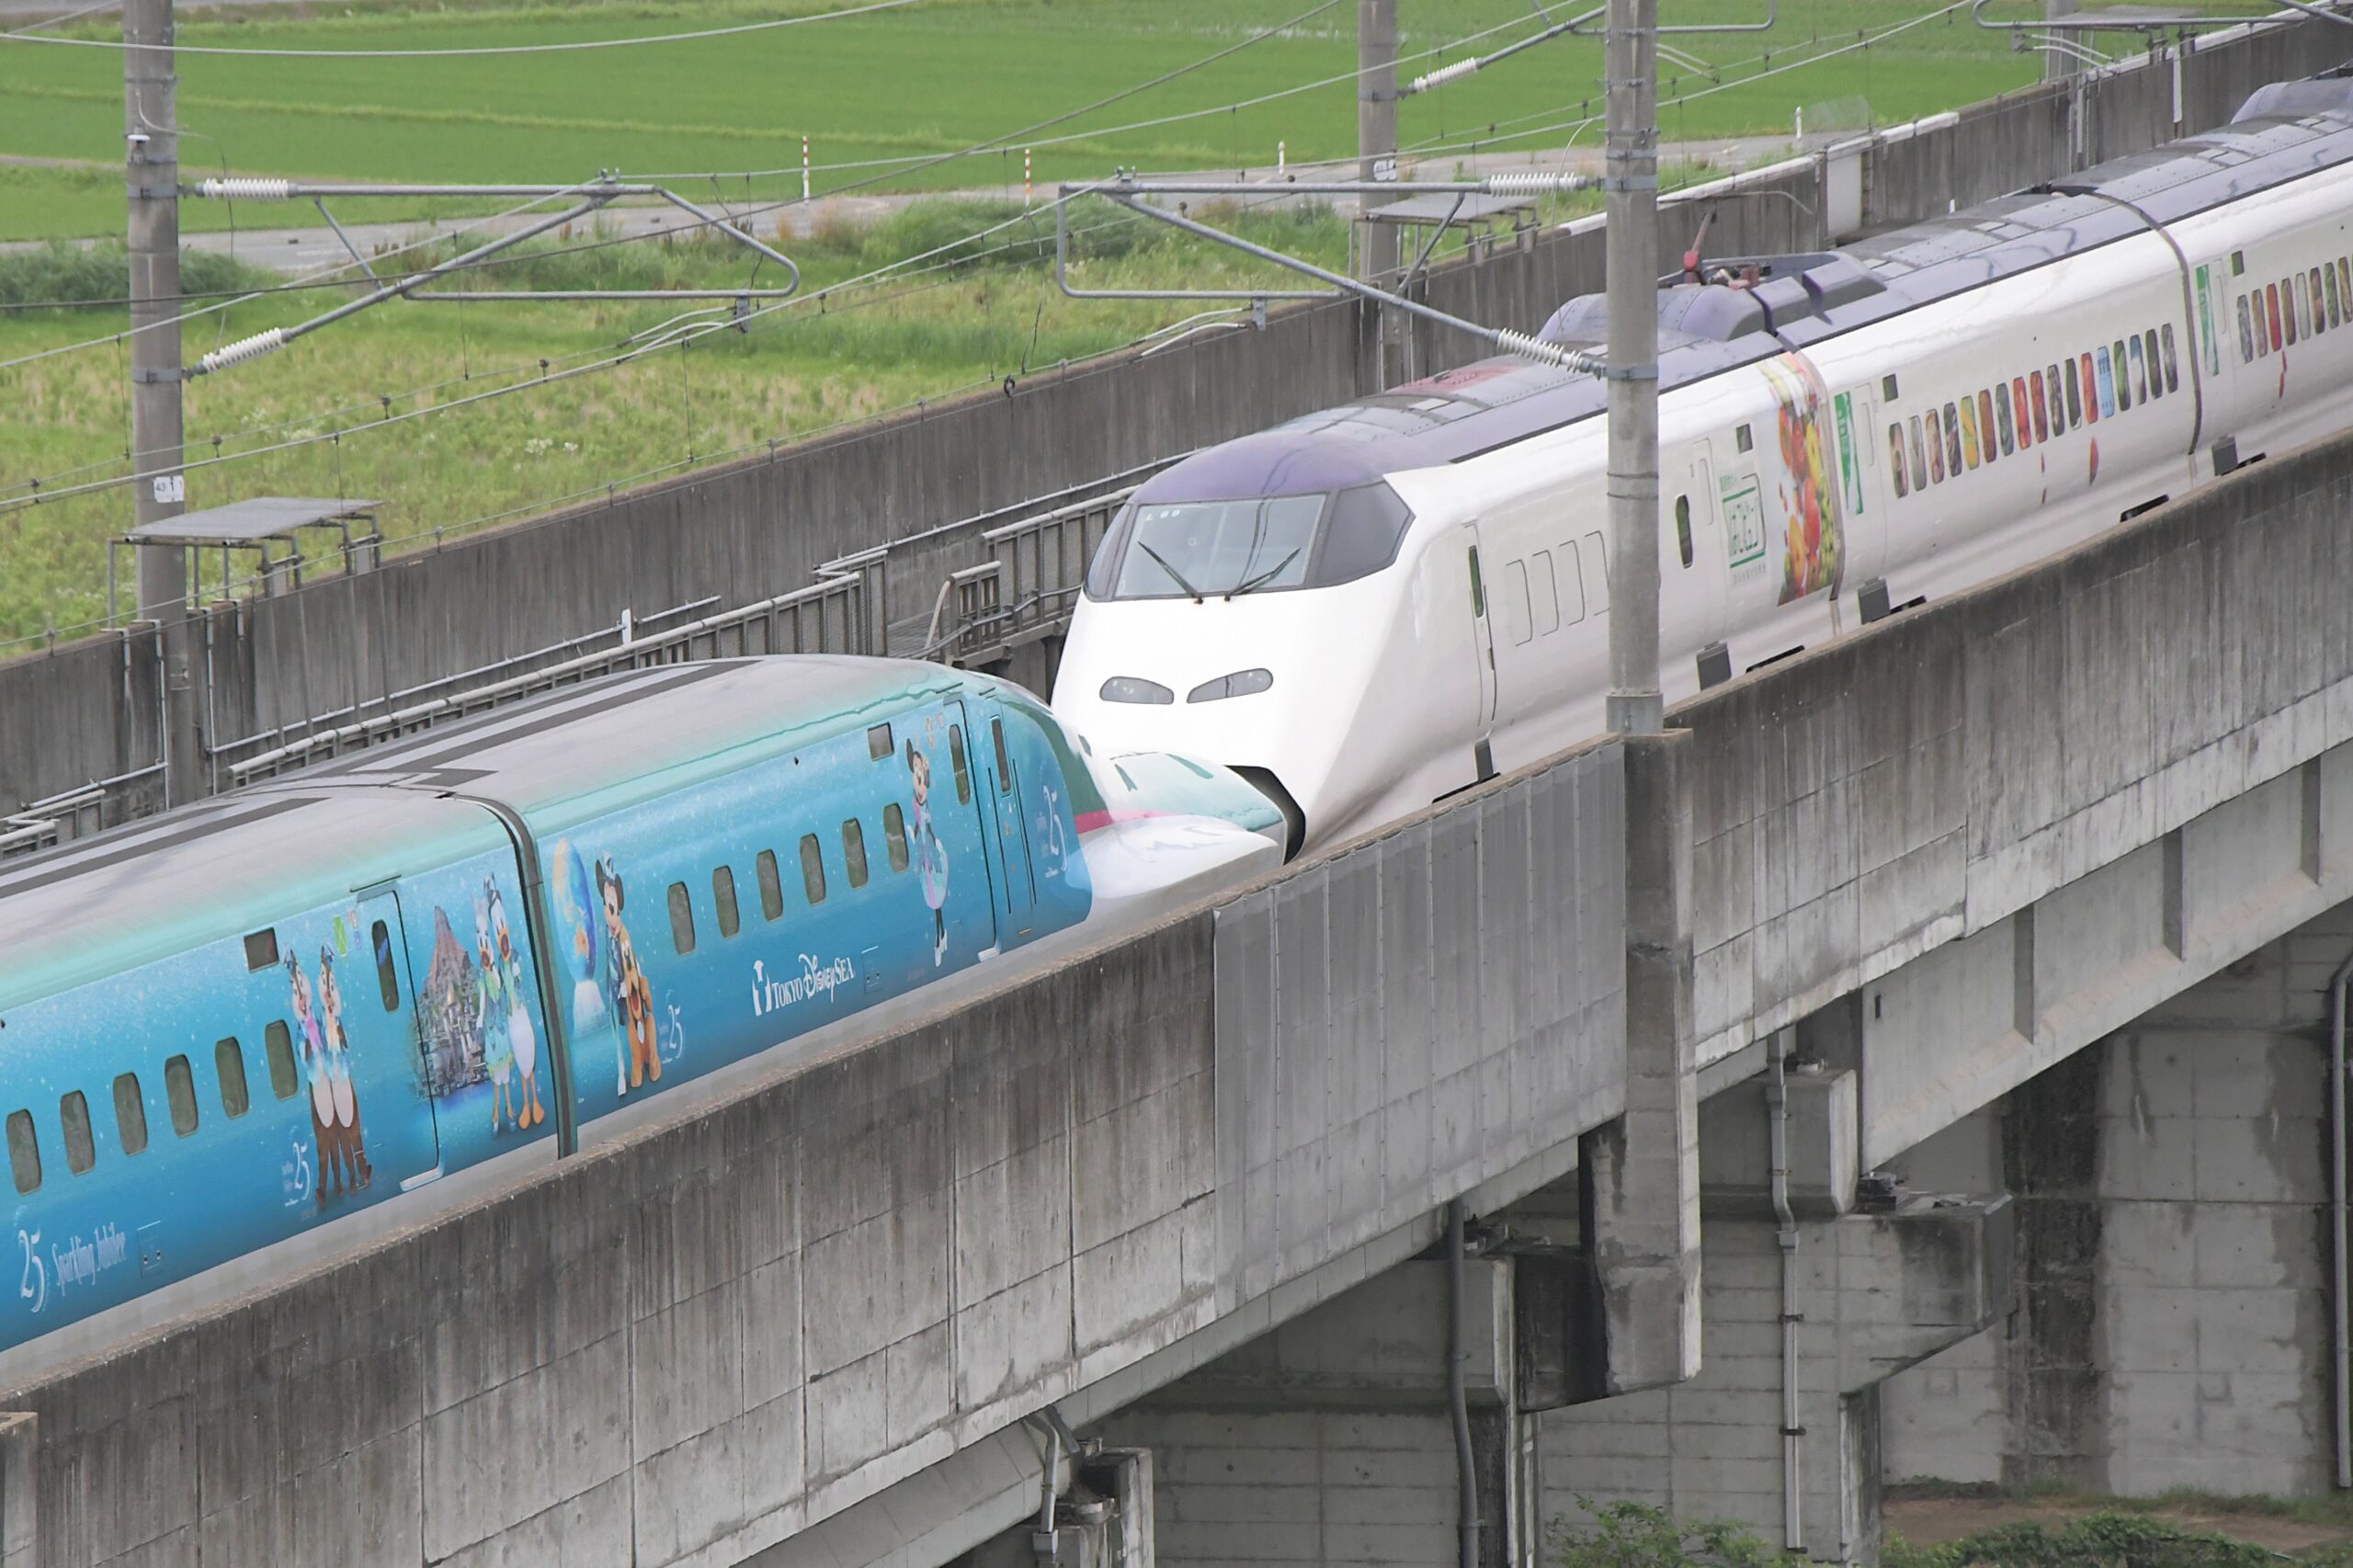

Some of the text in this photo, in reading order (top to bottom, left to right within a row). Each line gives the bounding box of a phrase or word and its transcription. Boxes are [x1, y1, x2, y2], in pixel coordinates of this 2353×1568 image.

[1042, 785, 1067, 872] 25
[771, 976, 803, 1009] TOKYO
[667, 1004, 683, 1060] 25
[293, 1142, 311, 1200] 25
[18, 1229, 45, 1313] 25
